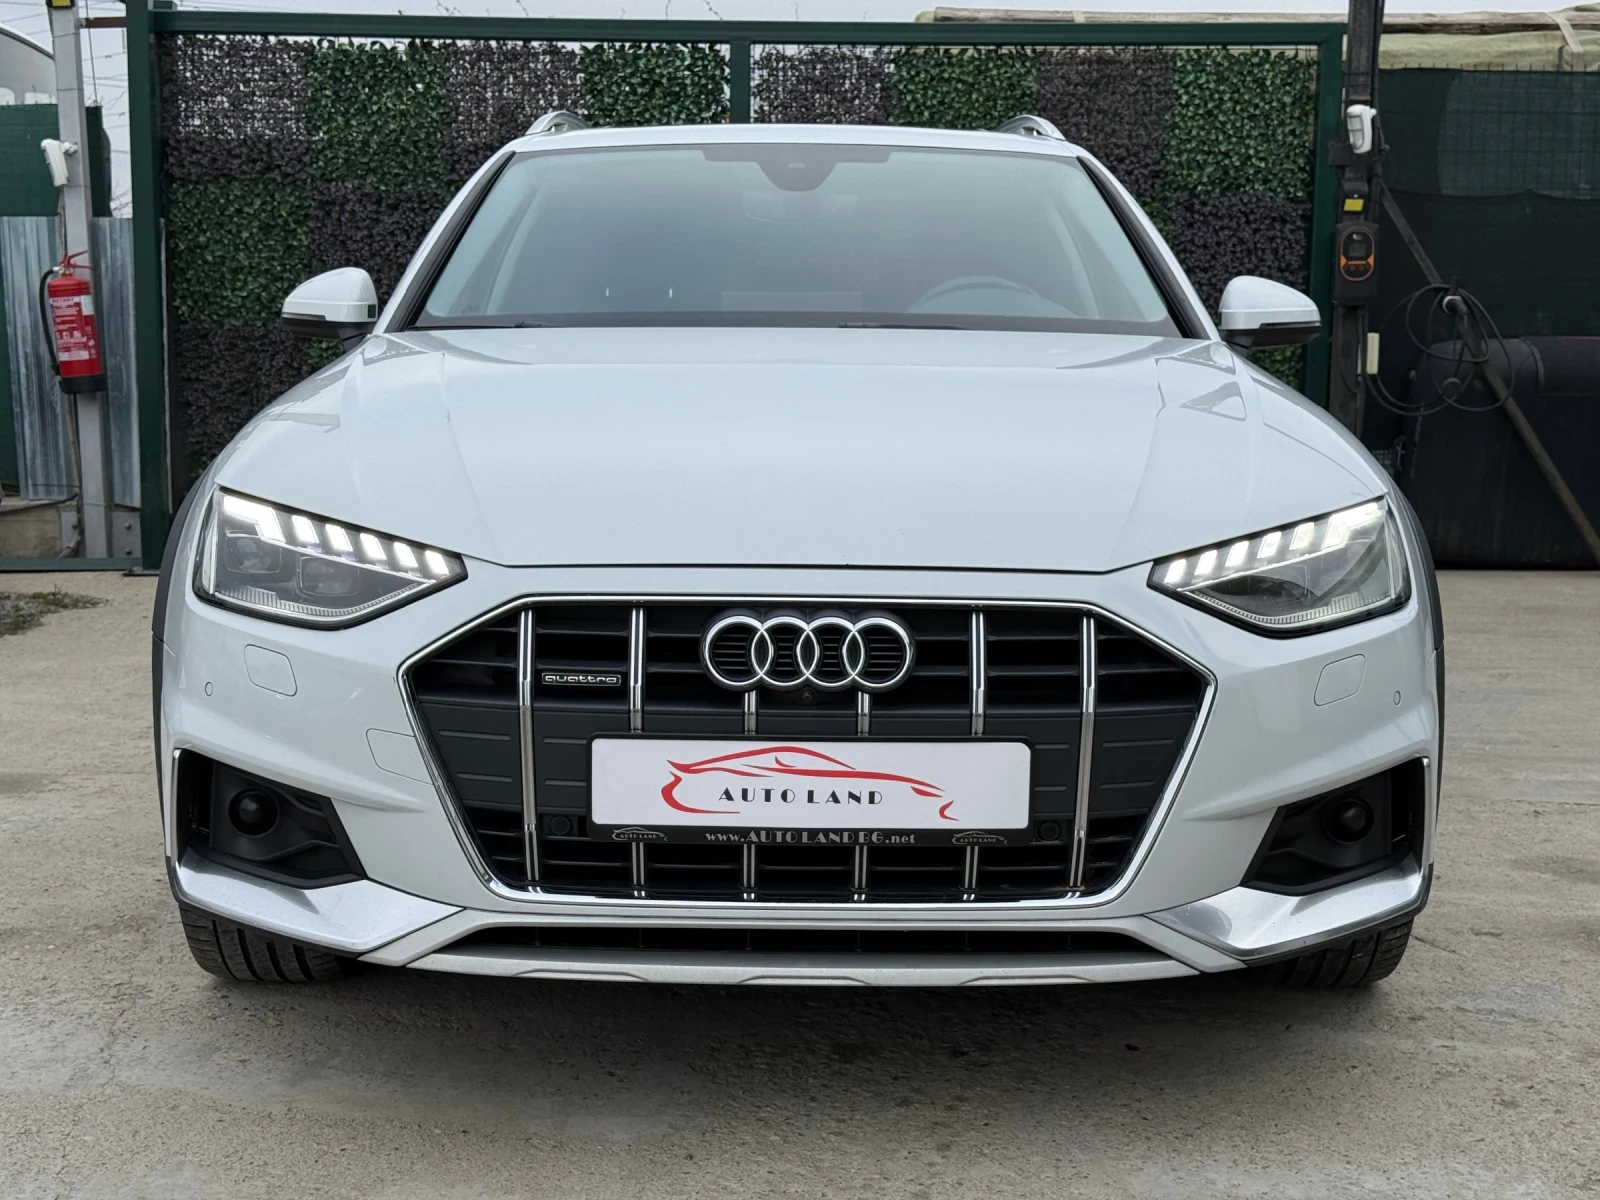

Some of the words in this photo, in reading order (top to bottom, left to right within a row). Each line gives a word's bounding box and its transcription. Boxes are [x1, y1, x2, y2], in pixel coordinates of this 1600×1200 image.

[545, 675, 617, 684] quattro
[718, 787, 796, 804] AUTO
[807, 789, 883, 805] LAND
